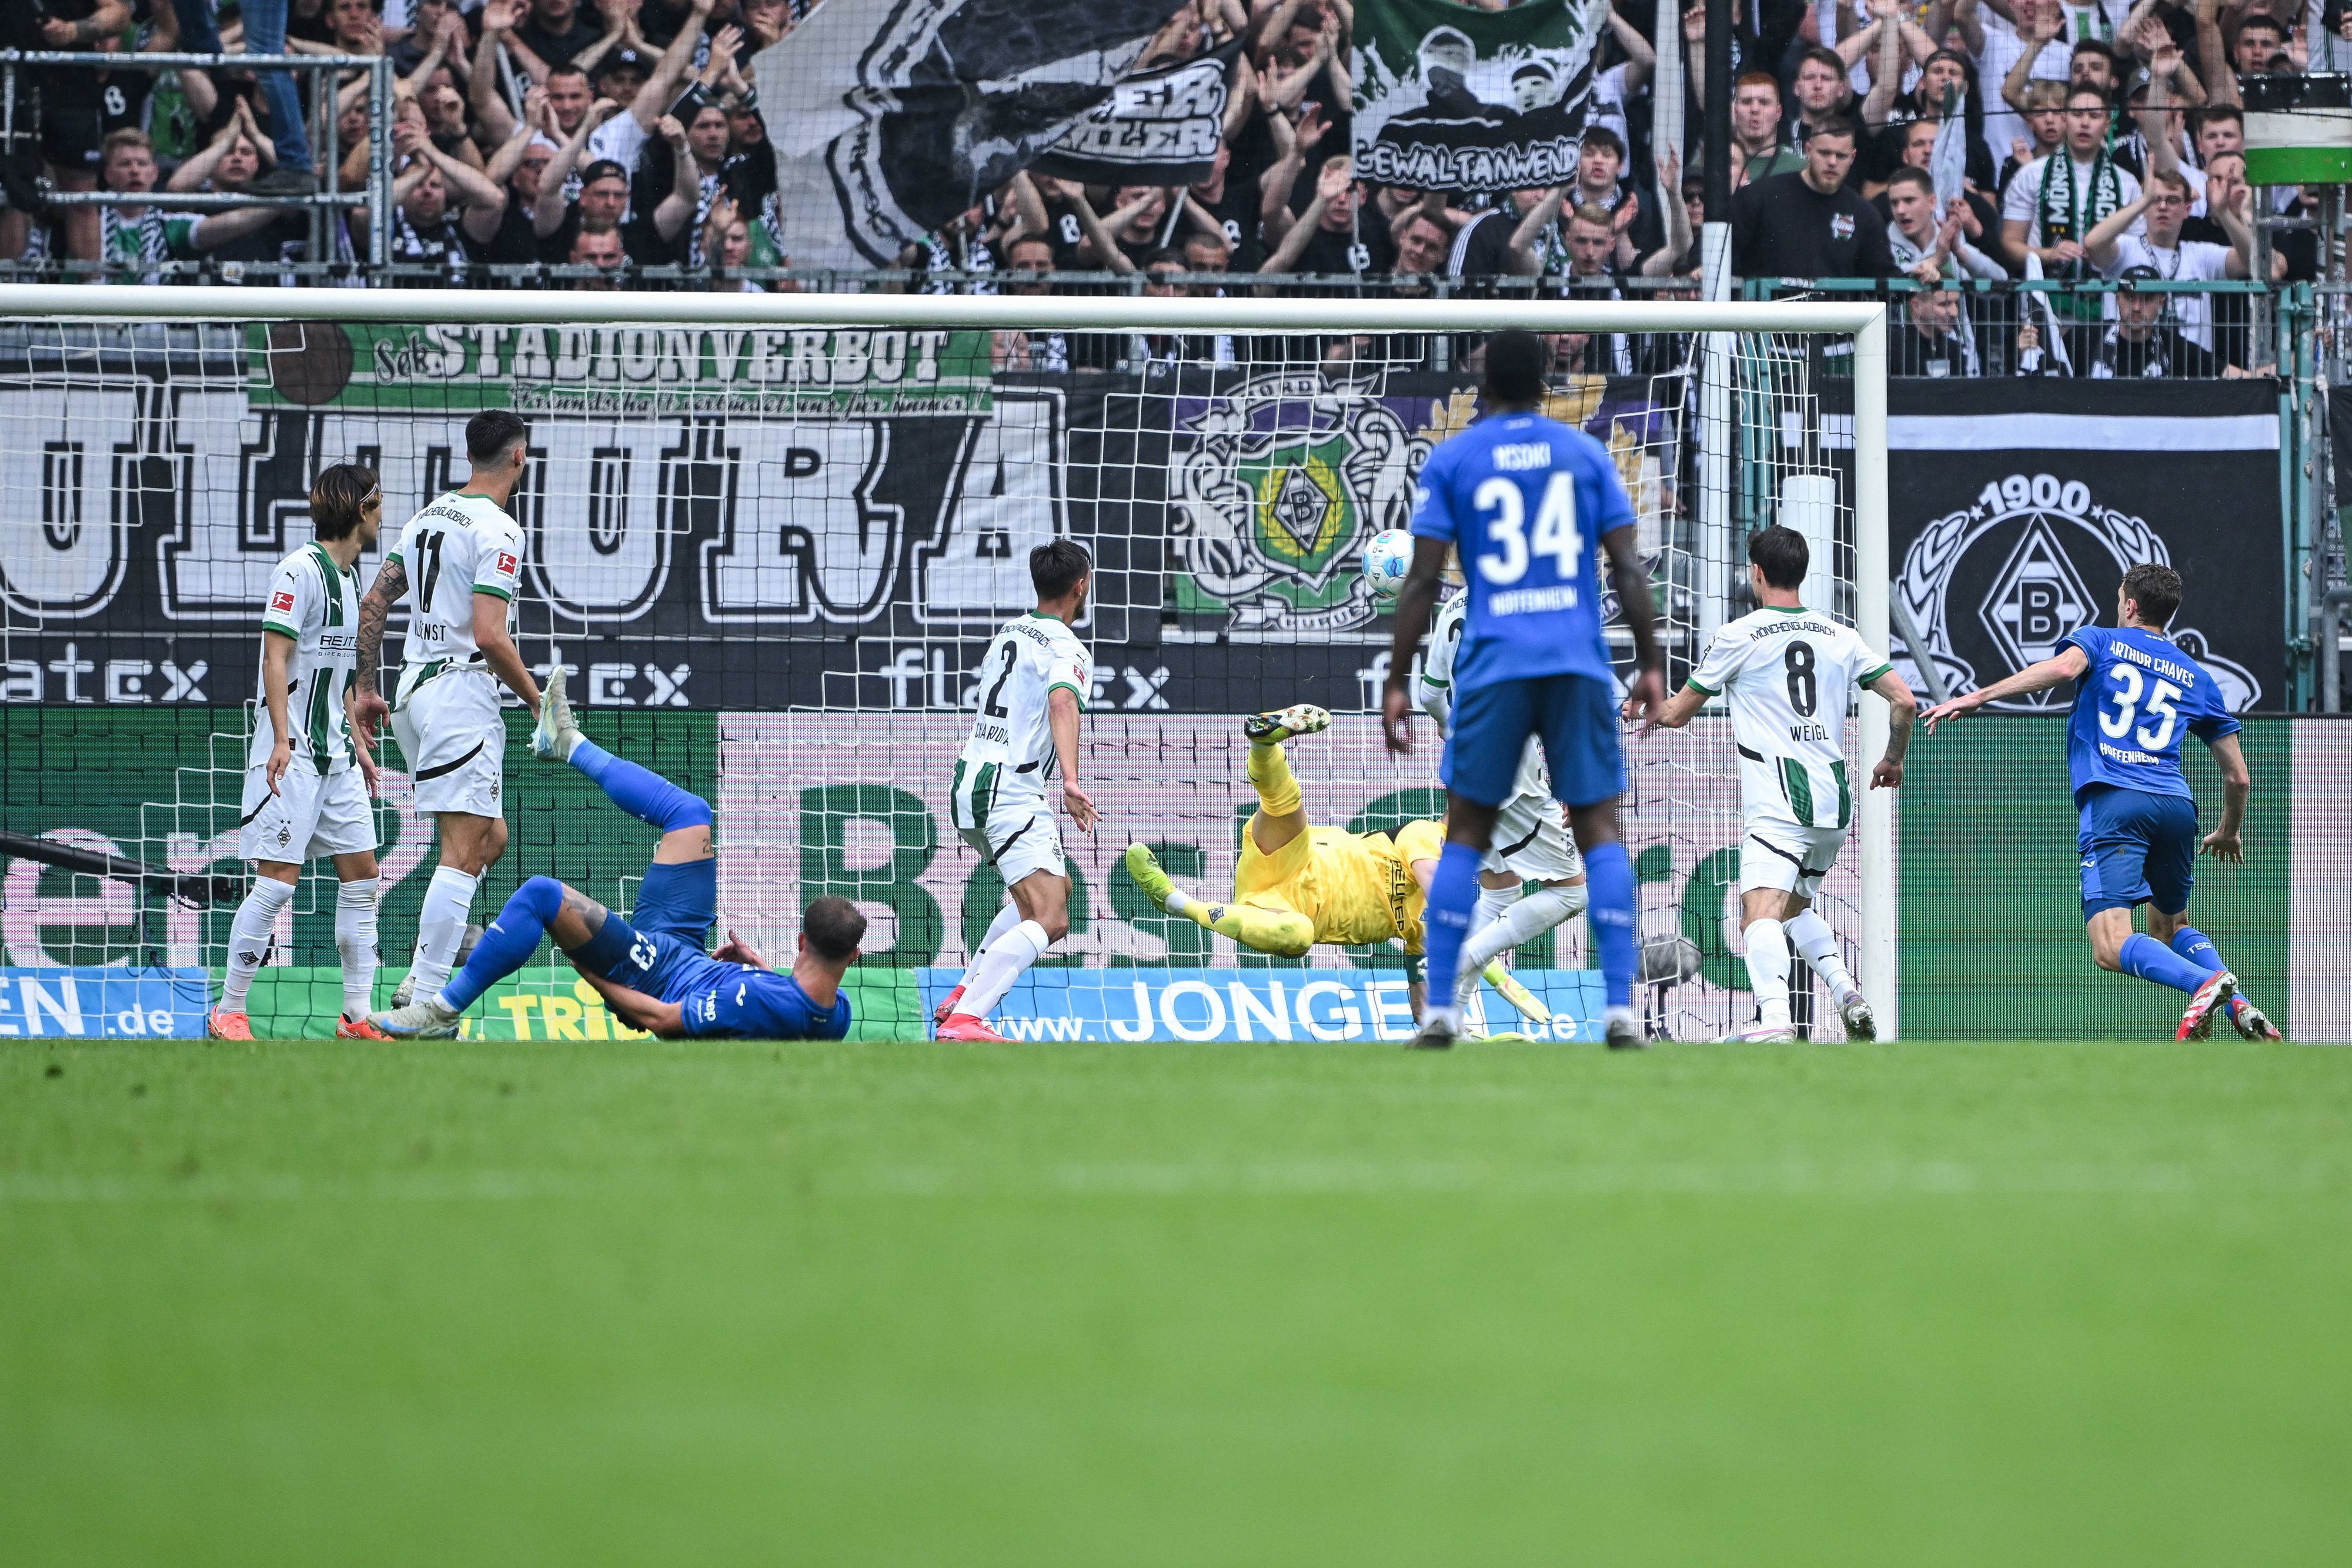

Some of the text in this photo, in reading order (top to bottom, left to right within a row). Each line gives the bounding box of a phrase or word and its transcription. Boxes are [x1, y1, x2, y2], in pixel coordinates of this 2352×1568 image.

[425, 325, 948, 383] STADIONVERBOT
[1978, 473, 2090, 516] 1900
[1474, 470, 1584, 586] 34
[415, 529, 445, 613] 11
[2019, 577, 2063, 647] B
[984, 640, 1017, 718] 2
[1785, 640, 1817, 717] 8
[2110, 640, 2194, 688] ARTHUR CHAVES
[1789, 724, 1829, 742] WEIGL
[2099, 663, 2183, 750] 35
[2100, 742, 2160, 765] HOFFENHEIM
[2187, 942, 2212, 955] TSG
